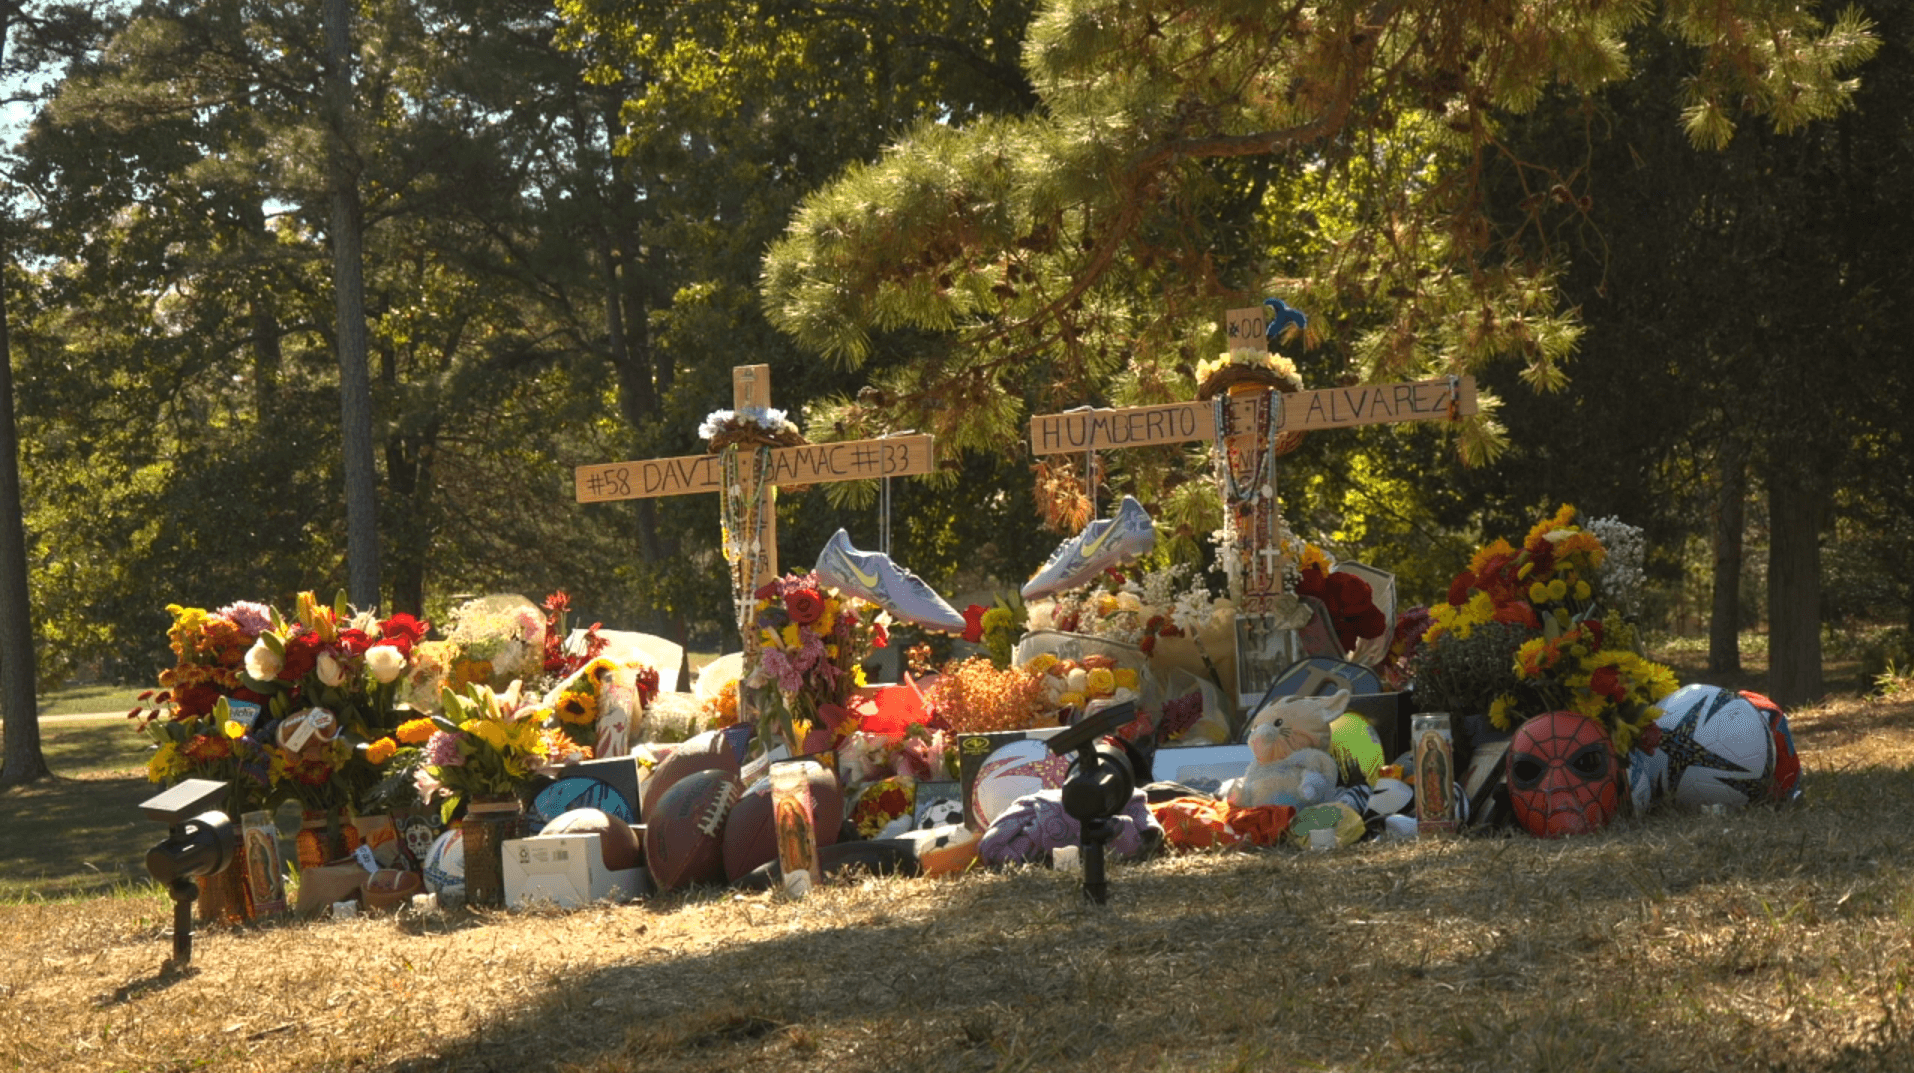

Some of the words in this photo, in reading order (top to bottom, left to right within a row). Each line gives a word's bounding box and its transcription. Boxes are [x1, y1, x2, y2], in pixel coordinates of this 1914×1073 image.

[1042, 406, 1196, 449] HUMBERTO
[1305, 381, 1452, 424] ALVAREZ
[587, 468, 630, 497] #58
[643, 455, 721, 492] DAVI
[851, 444, 909, 475] #33
